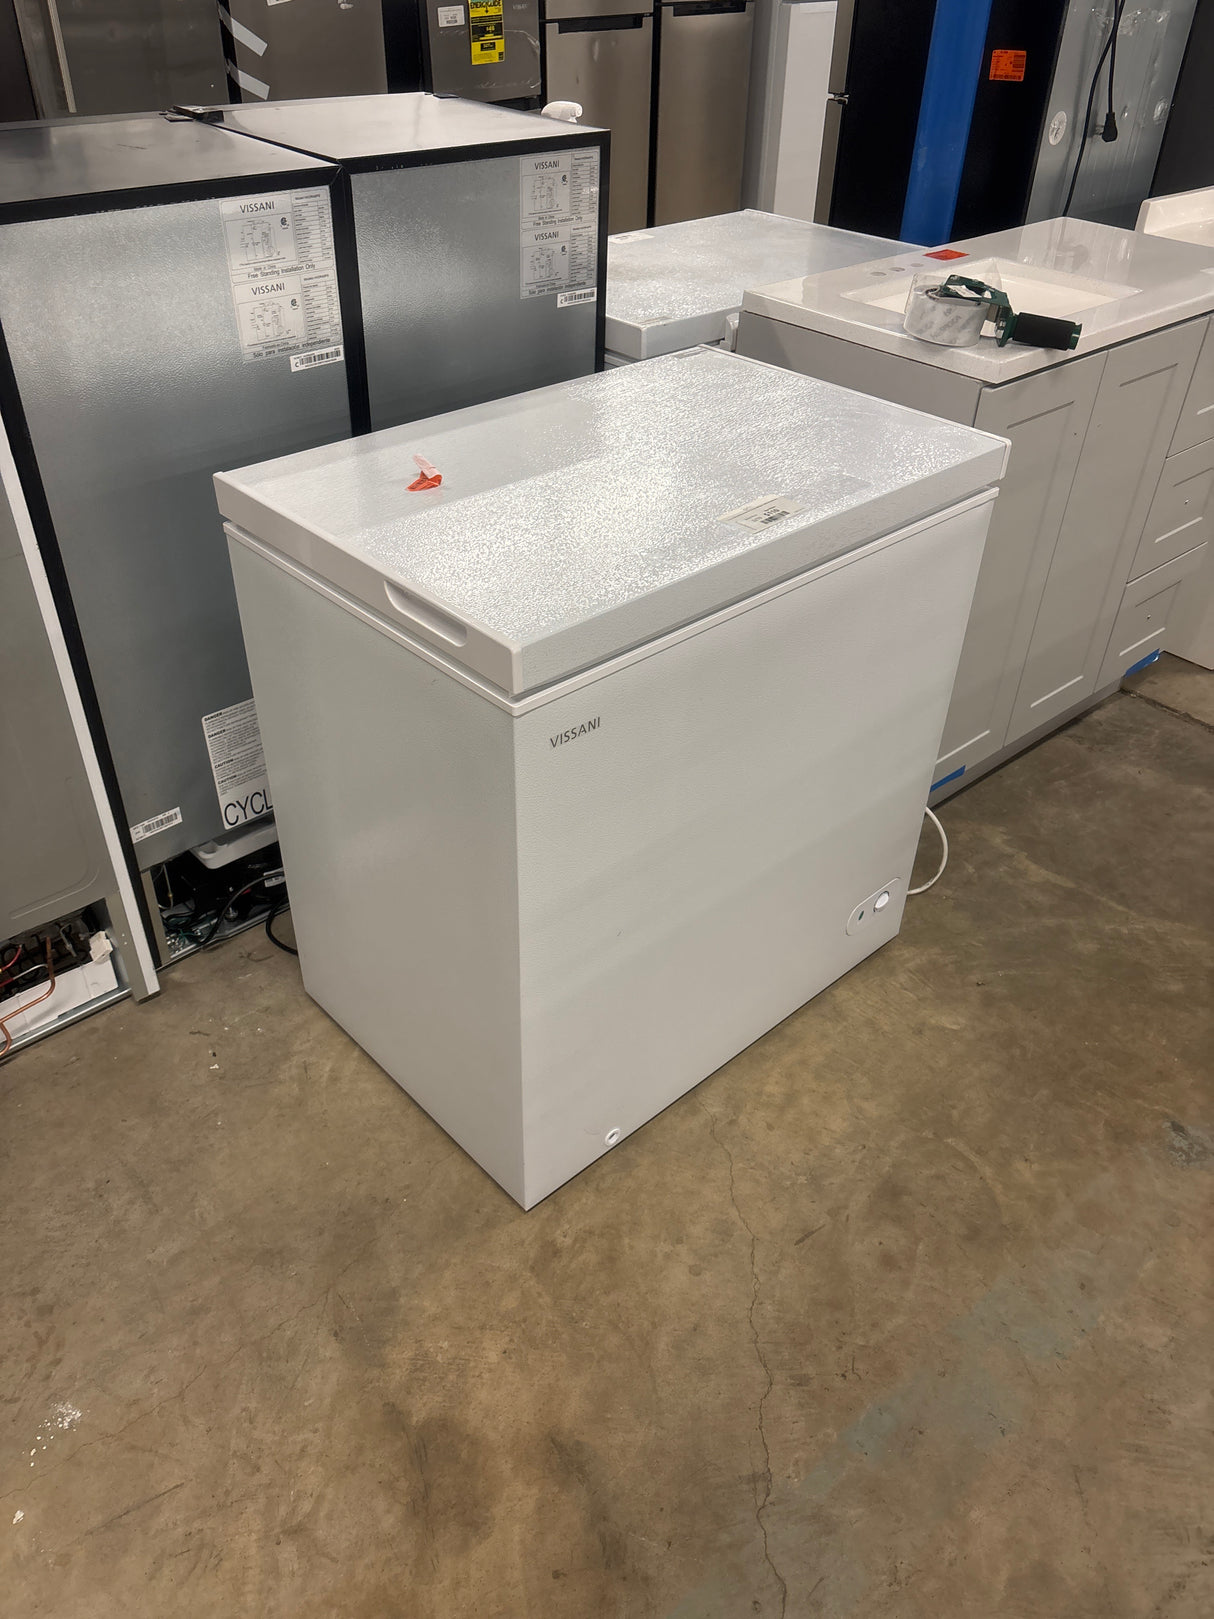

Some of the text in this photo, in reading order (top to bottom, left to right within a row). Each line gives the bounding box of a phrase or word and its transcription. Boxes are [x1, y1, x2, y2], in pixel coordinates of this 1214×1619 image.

[534, 160, 560, 170] VISSANI
[239, 201, 275, 213] VISSANI
[534, 231, 559, 241] VISSANI
[260, 269, 280, 277] Standing
[281, 265, 304, 274] Installation
[251, 282, 285, 296] VISSANI
[204, 712, 223, 722] DANGER
[208, 729, 226, 739] DANGER
[550, 716, 600, 748] VISSANI
[214, 758, 234, 769] CAUTION
[218, 774, 237, 785] CAUTION
